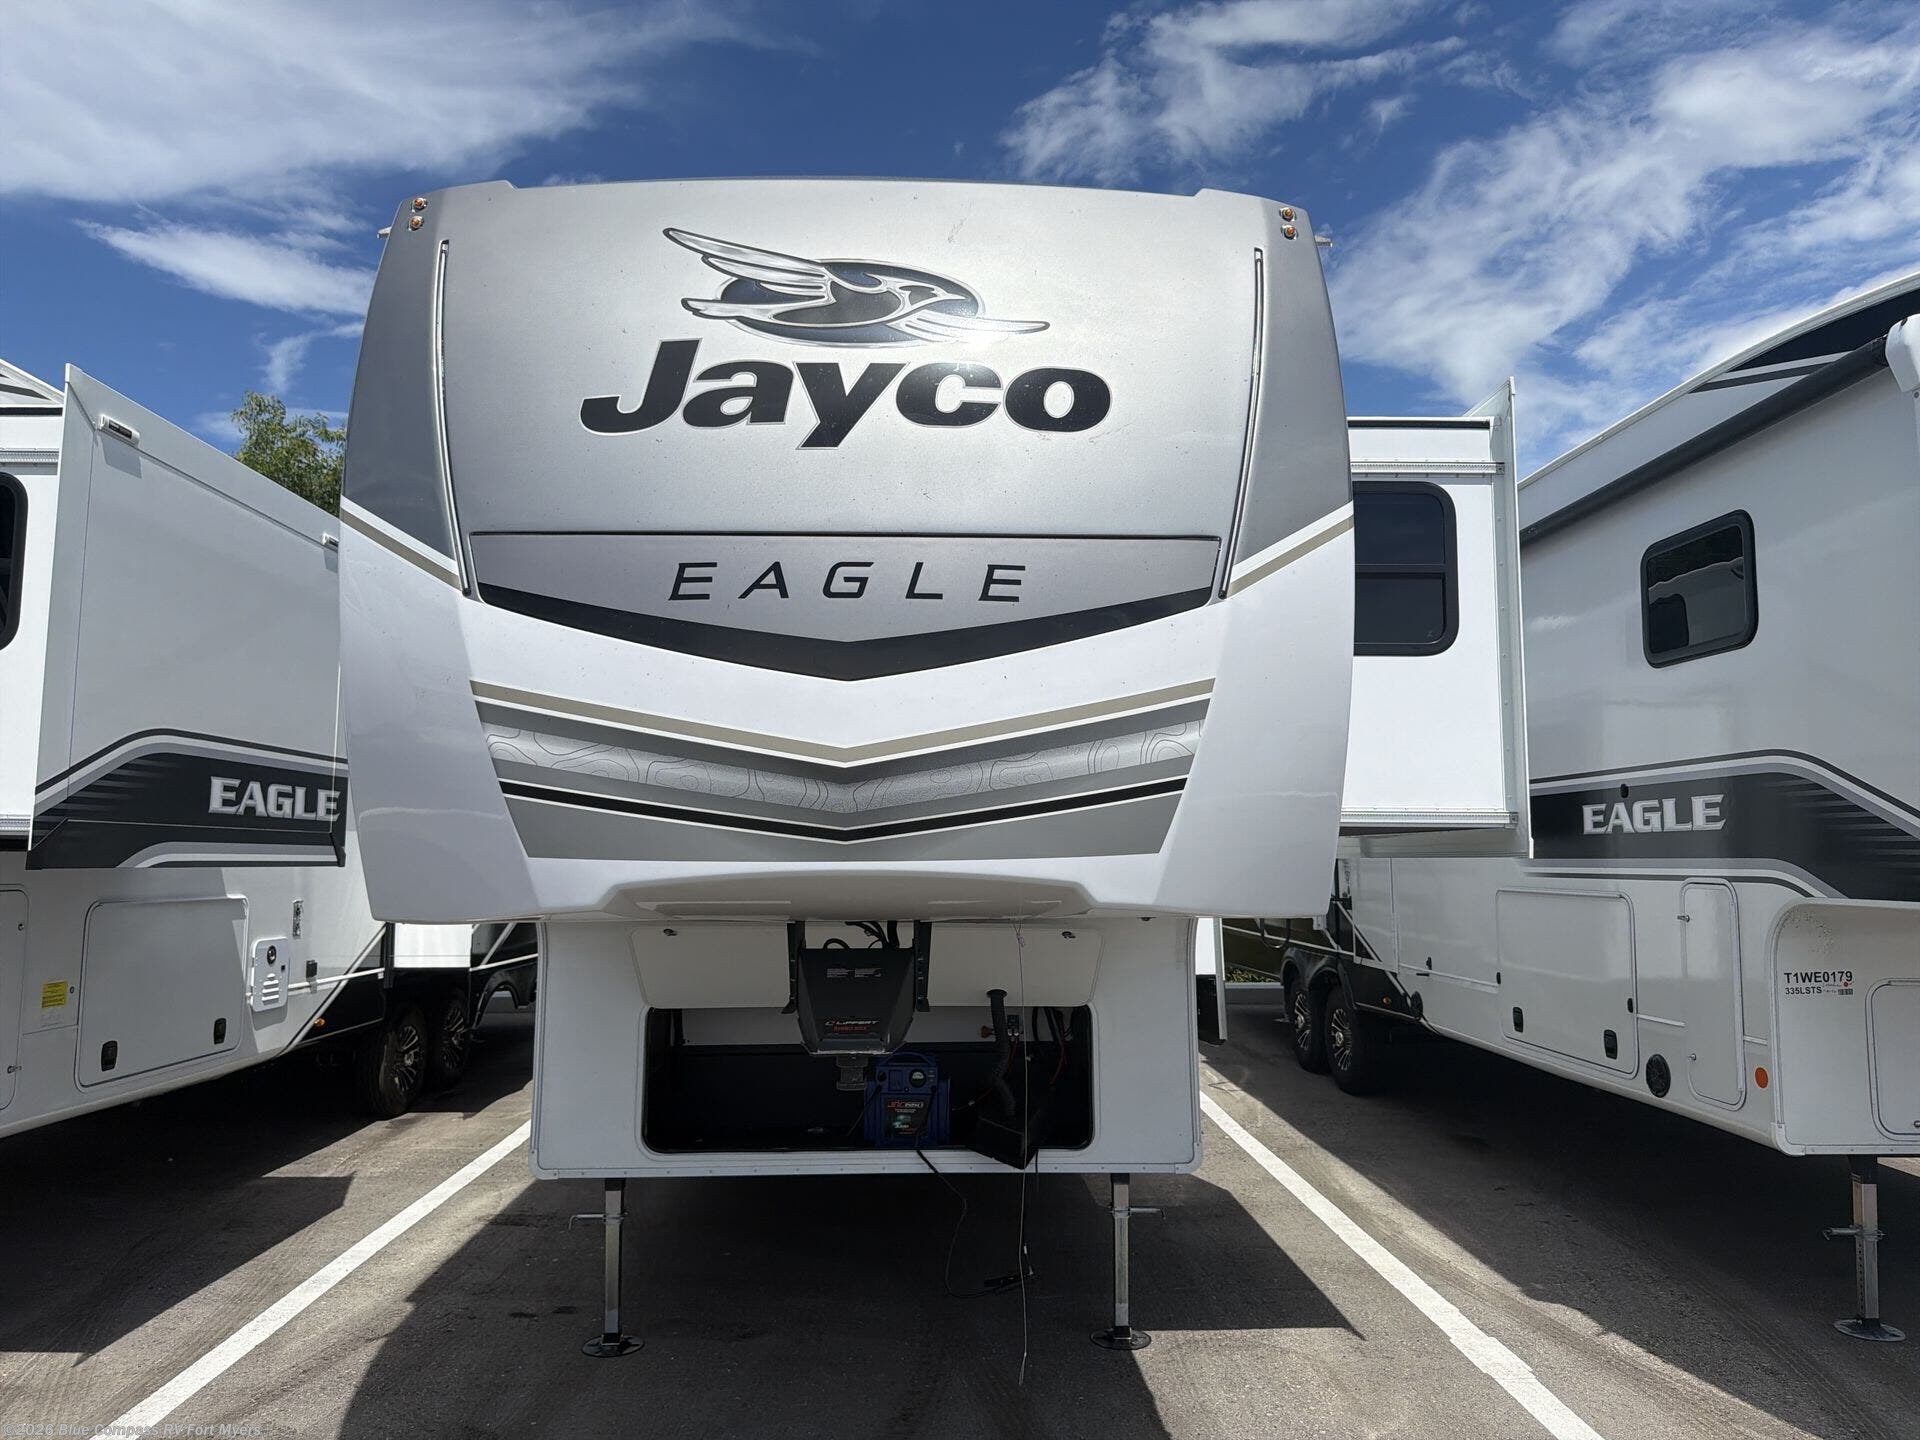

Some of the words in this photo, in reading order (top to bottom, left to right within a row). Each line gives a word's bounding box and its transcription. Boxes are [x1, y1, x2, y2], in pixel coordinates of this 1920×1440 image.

[580, 338, 1112, 449] Jayco
[669, 561, 1026, 602] EAGLE
[208, 776, 341, 822] EAGLE
[1582, 794, 1726, 835] EAGLE
[1784, 971, 1853, 983] T1WE0179
[1785, 987, 1822, 995] 335LSTS
